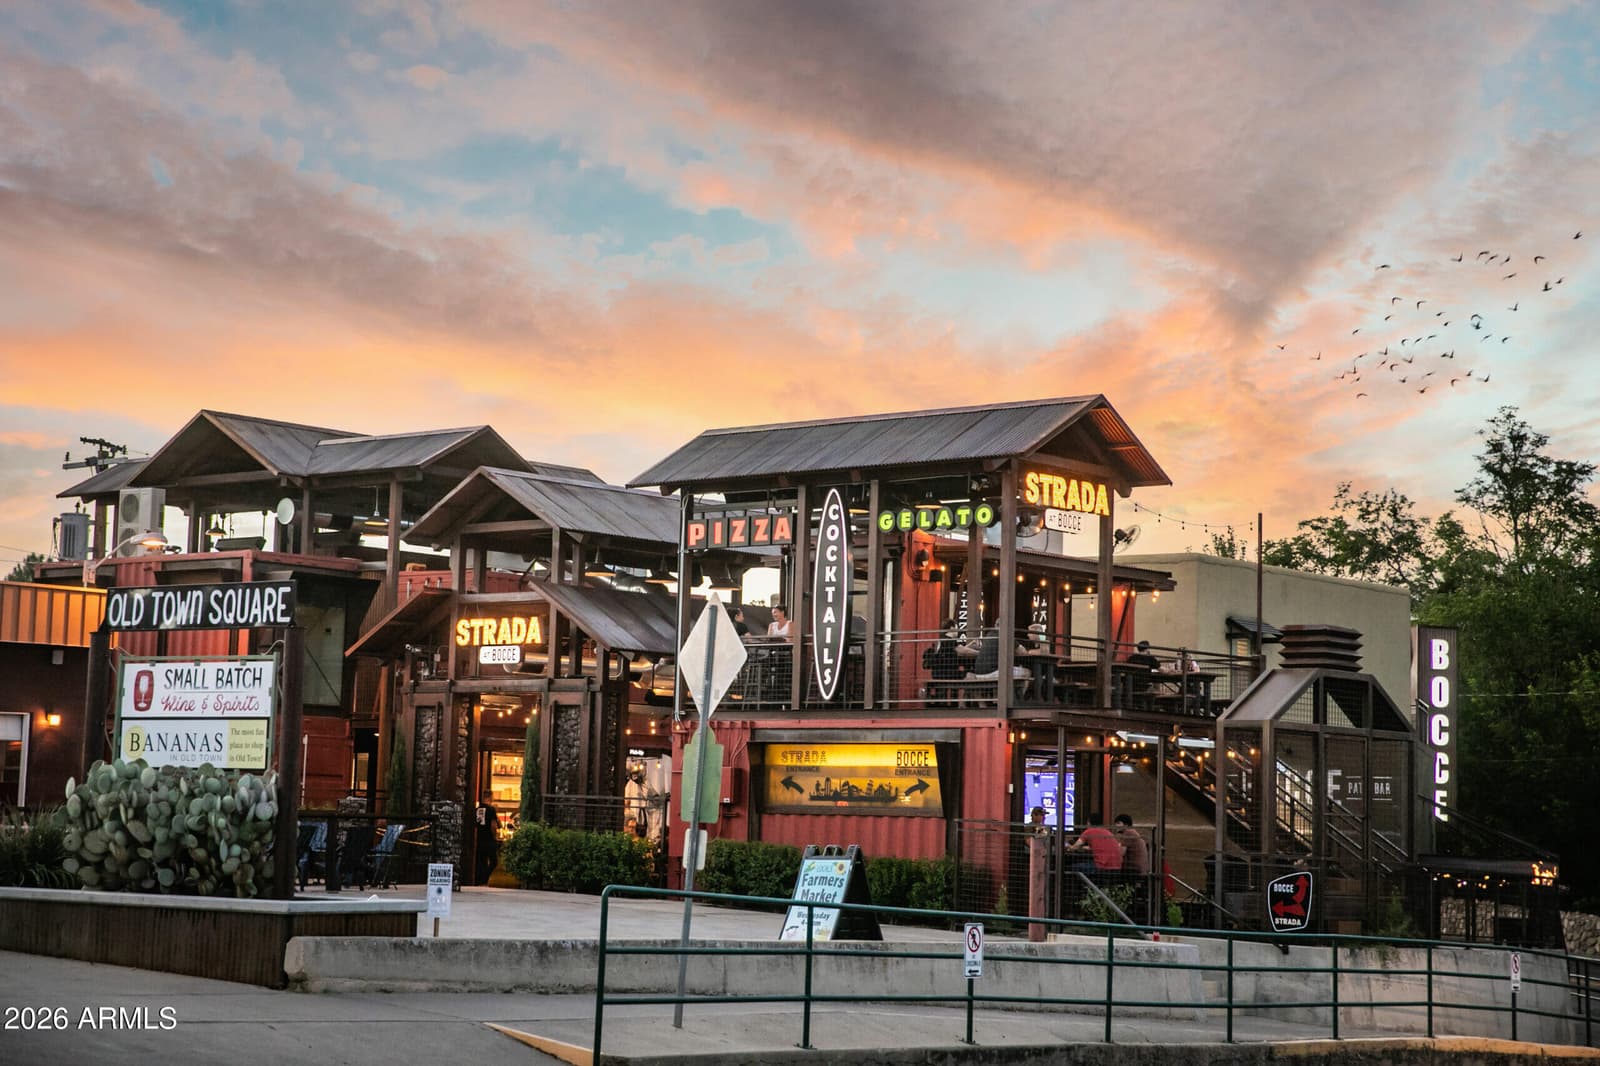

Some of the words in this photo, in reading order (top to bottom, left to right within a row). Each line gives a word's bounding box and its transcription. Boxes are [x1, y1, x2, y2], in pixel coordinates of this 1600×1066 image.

[1025, 471, 1110, 517] STRADA
[880, 507, 992, 531] GELATO
[1058, 512, 1081, 531] BOCCE
[688, 517, 792, 546] PIZZA
[822, 503, 840, 685] COCKTAILS
[108, 592, 144, 627] OLD
[208, 586, 291, 625] SQUARE
[456, 616, 541, 646] STRADA
[492, 648, 516, 662] BOCCE
[163, 668, 209, 691] SMALL
[215, 666, 262, 690] BATCH
[160, 694, 196, 712] Wine
[213, 694, 260, 715] Spirits
[1430, 638, 1450, 822] BOCCE
[129, 731, 223, 753] BANANAS
[169, 753, 178, 762] IN
[180, 753, 197, 762] OLD
[200, 753, 223, 762] TOWN
[780, 750, 827, 763] STRADA
[896, 751, 929, 767] BOCCE
[894, 768, 930, 776] ENTRANCE
[1374, 782, 1391, 794] BAR
[430, 869, 451, 878] ZONING
[801, 873, 845, 889] Farmers
[800, 889, 838, 903] Market
[1273, 883, 1295, 894] BOCCE
[1274, 917, 1302, 926] STRADA
